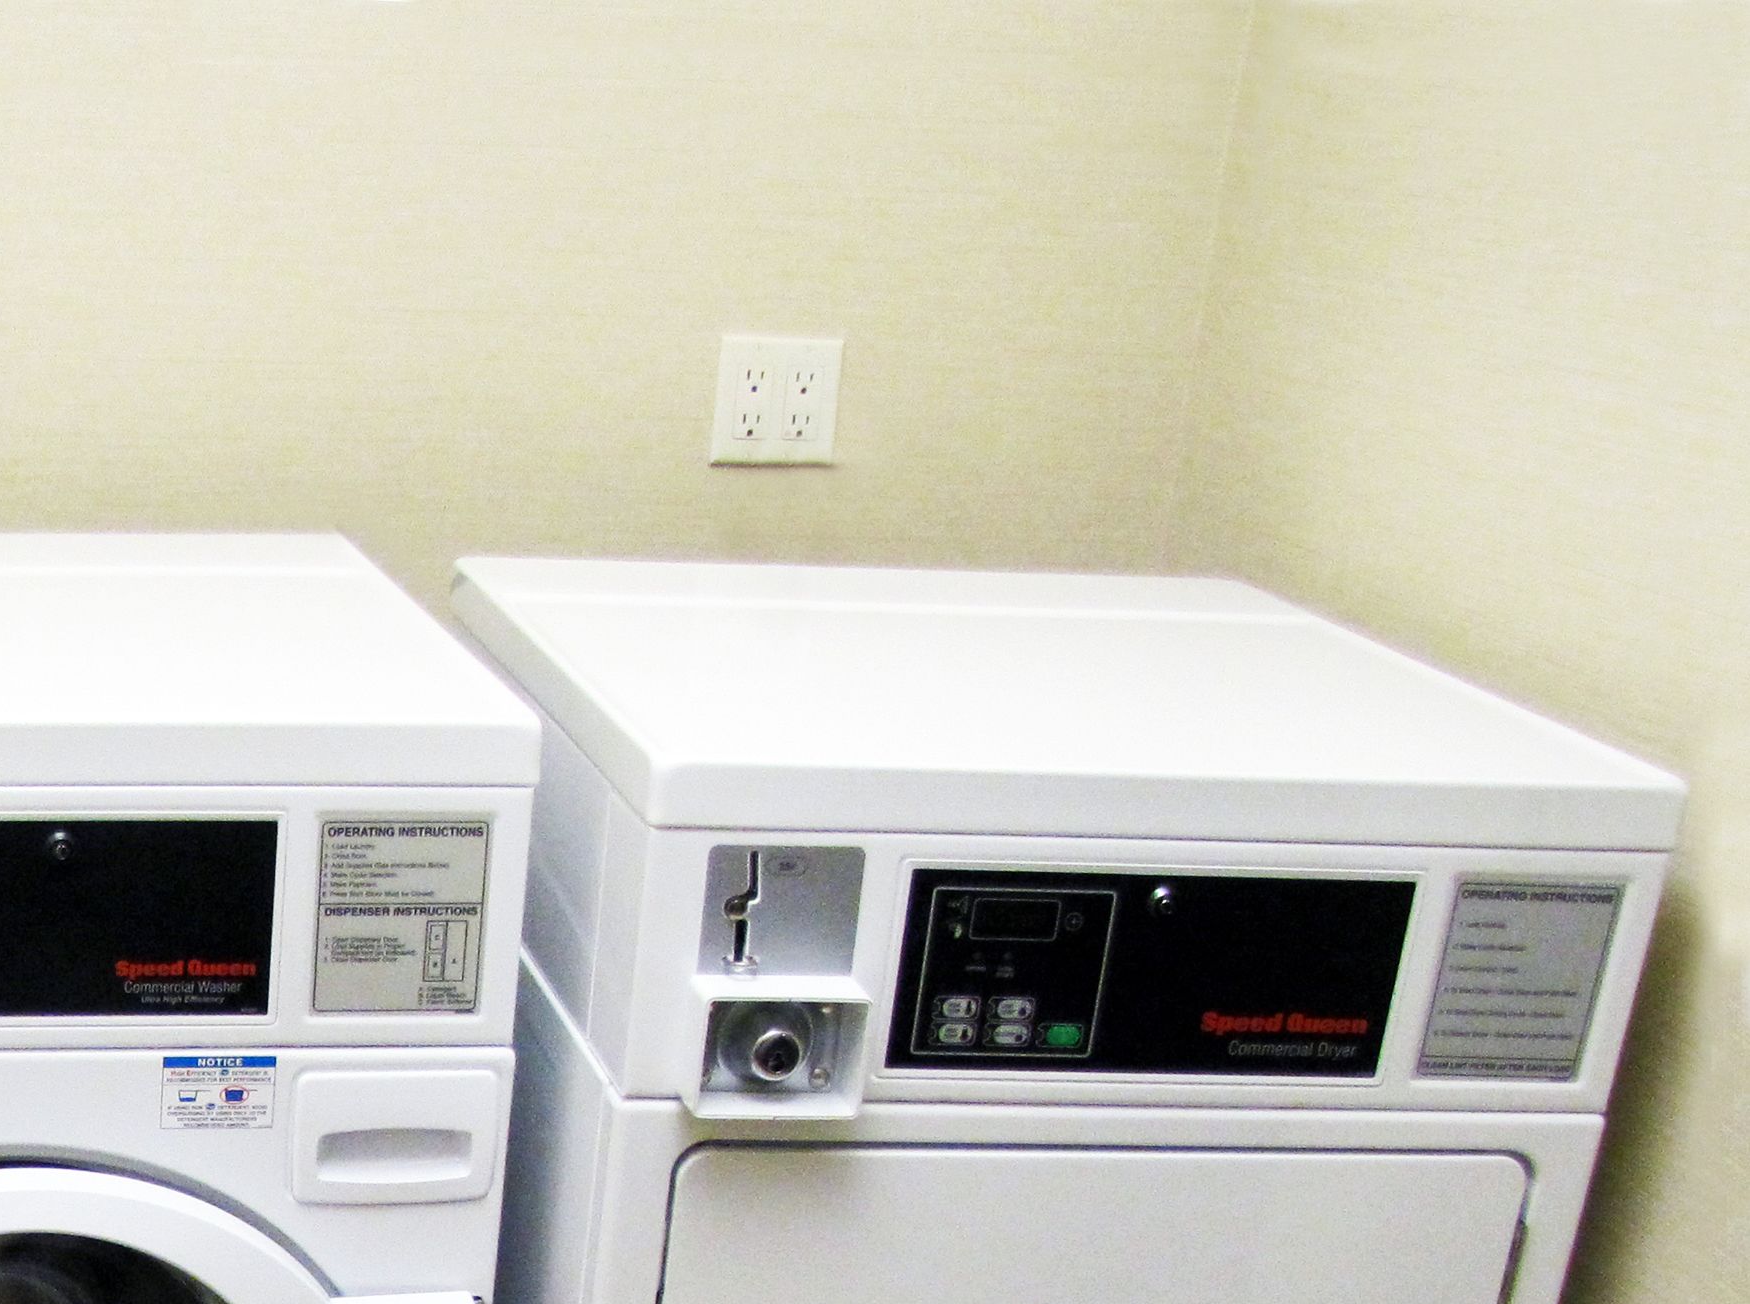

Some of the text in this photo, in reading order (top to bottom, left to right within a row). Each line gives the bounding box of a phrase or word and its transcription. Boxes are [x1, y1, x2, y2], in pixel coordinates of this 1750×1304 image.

[327, 826, 484, 838] OPERATING INSTRUCTIONS
[324, 906, 479, 917] DISPENSER INSTRUCTIONS
[115, 958, 257, 980] Speed Queen
[123, 980, 243, 994] Commercial Washer
[1201, 1011, 1368, 1036] Speed Queen
[1228, 1040, 1357, 1060] Commercial Dryer
[197, 1058, 243, 1067] NOTICE
